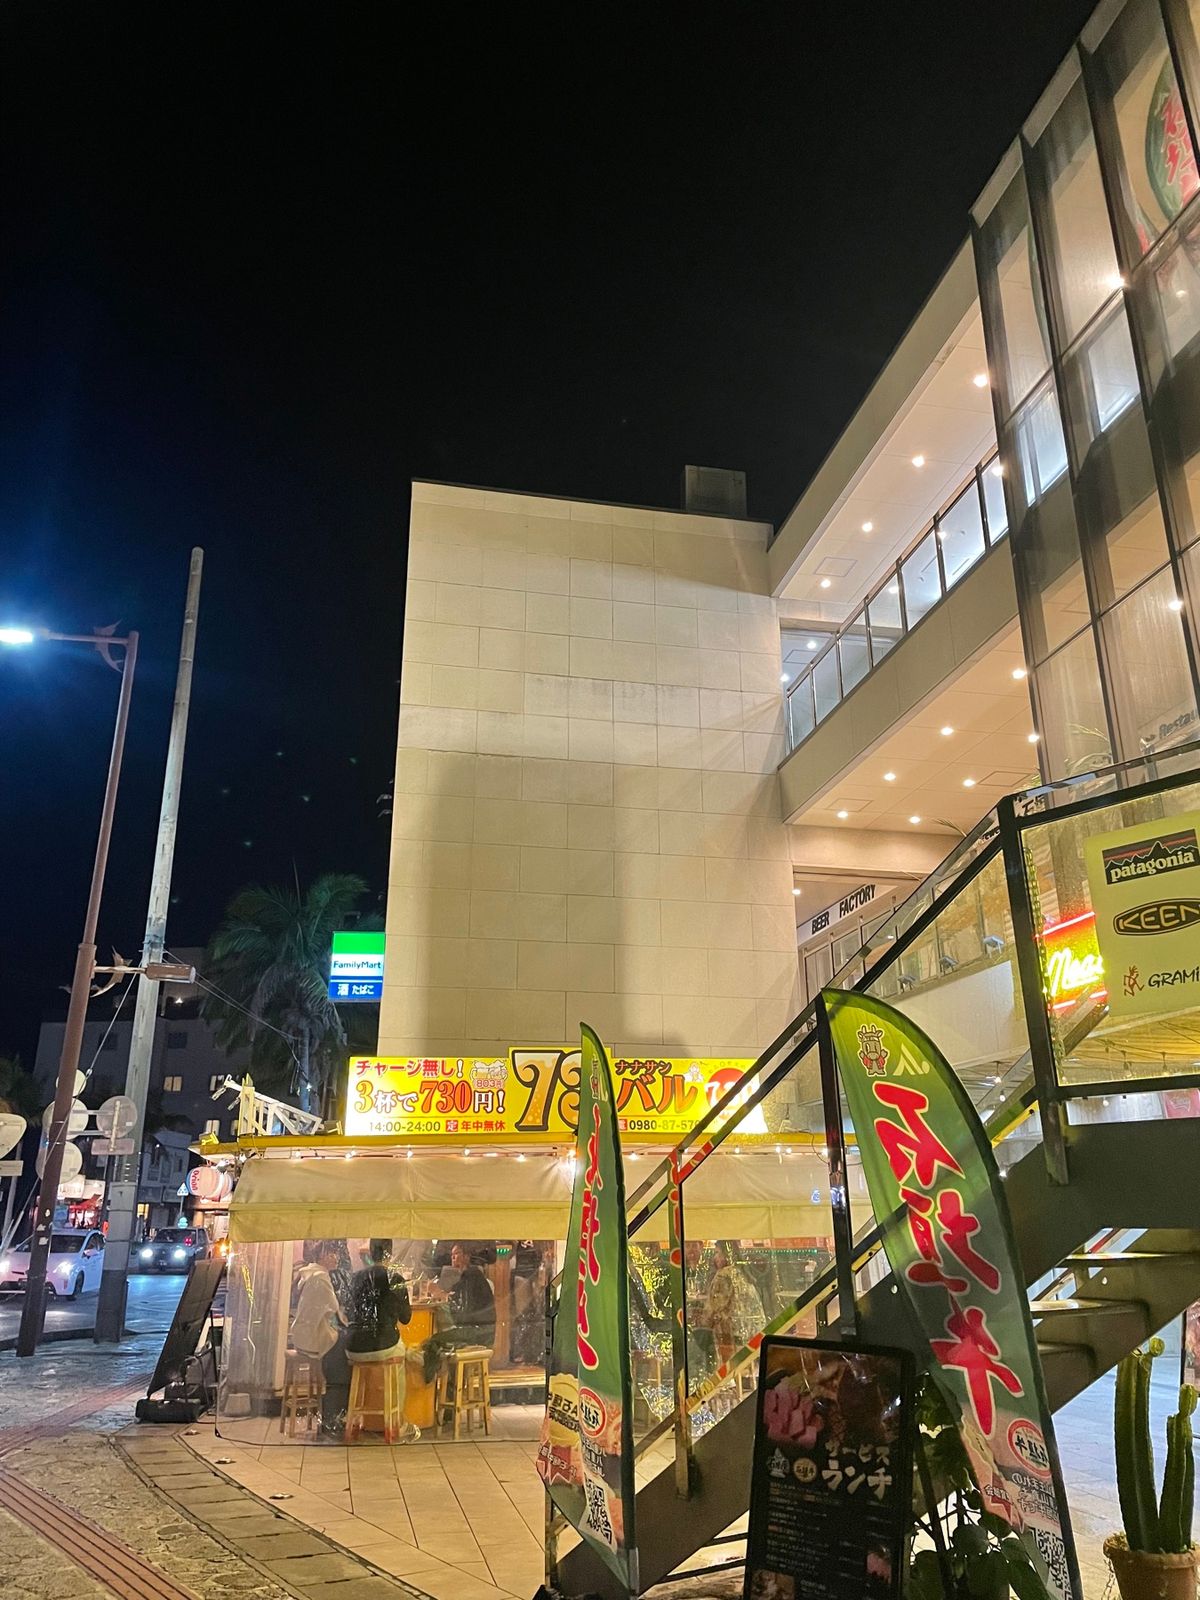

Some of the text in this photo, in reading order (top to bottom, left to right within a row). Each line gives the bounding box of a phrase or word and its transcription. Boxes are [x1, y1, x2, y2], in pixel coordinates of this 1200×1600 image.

[1110, 851, 1195, 882] patagonia
[811, 884, 876, 935] BEER FACTORY
[333, 960, 382, 970] FamilyMart
[351, 984, 375, 995] たばこ
[614, 1059, 672, 1075] ナナサン
[616, 1073, 698, 1114] バル
[369, 1121, 441, 1132] 14:00-24:00
[461, 1120, 506, 1132] 年中無休
[821, 1459, 893, 1501] ランチ
